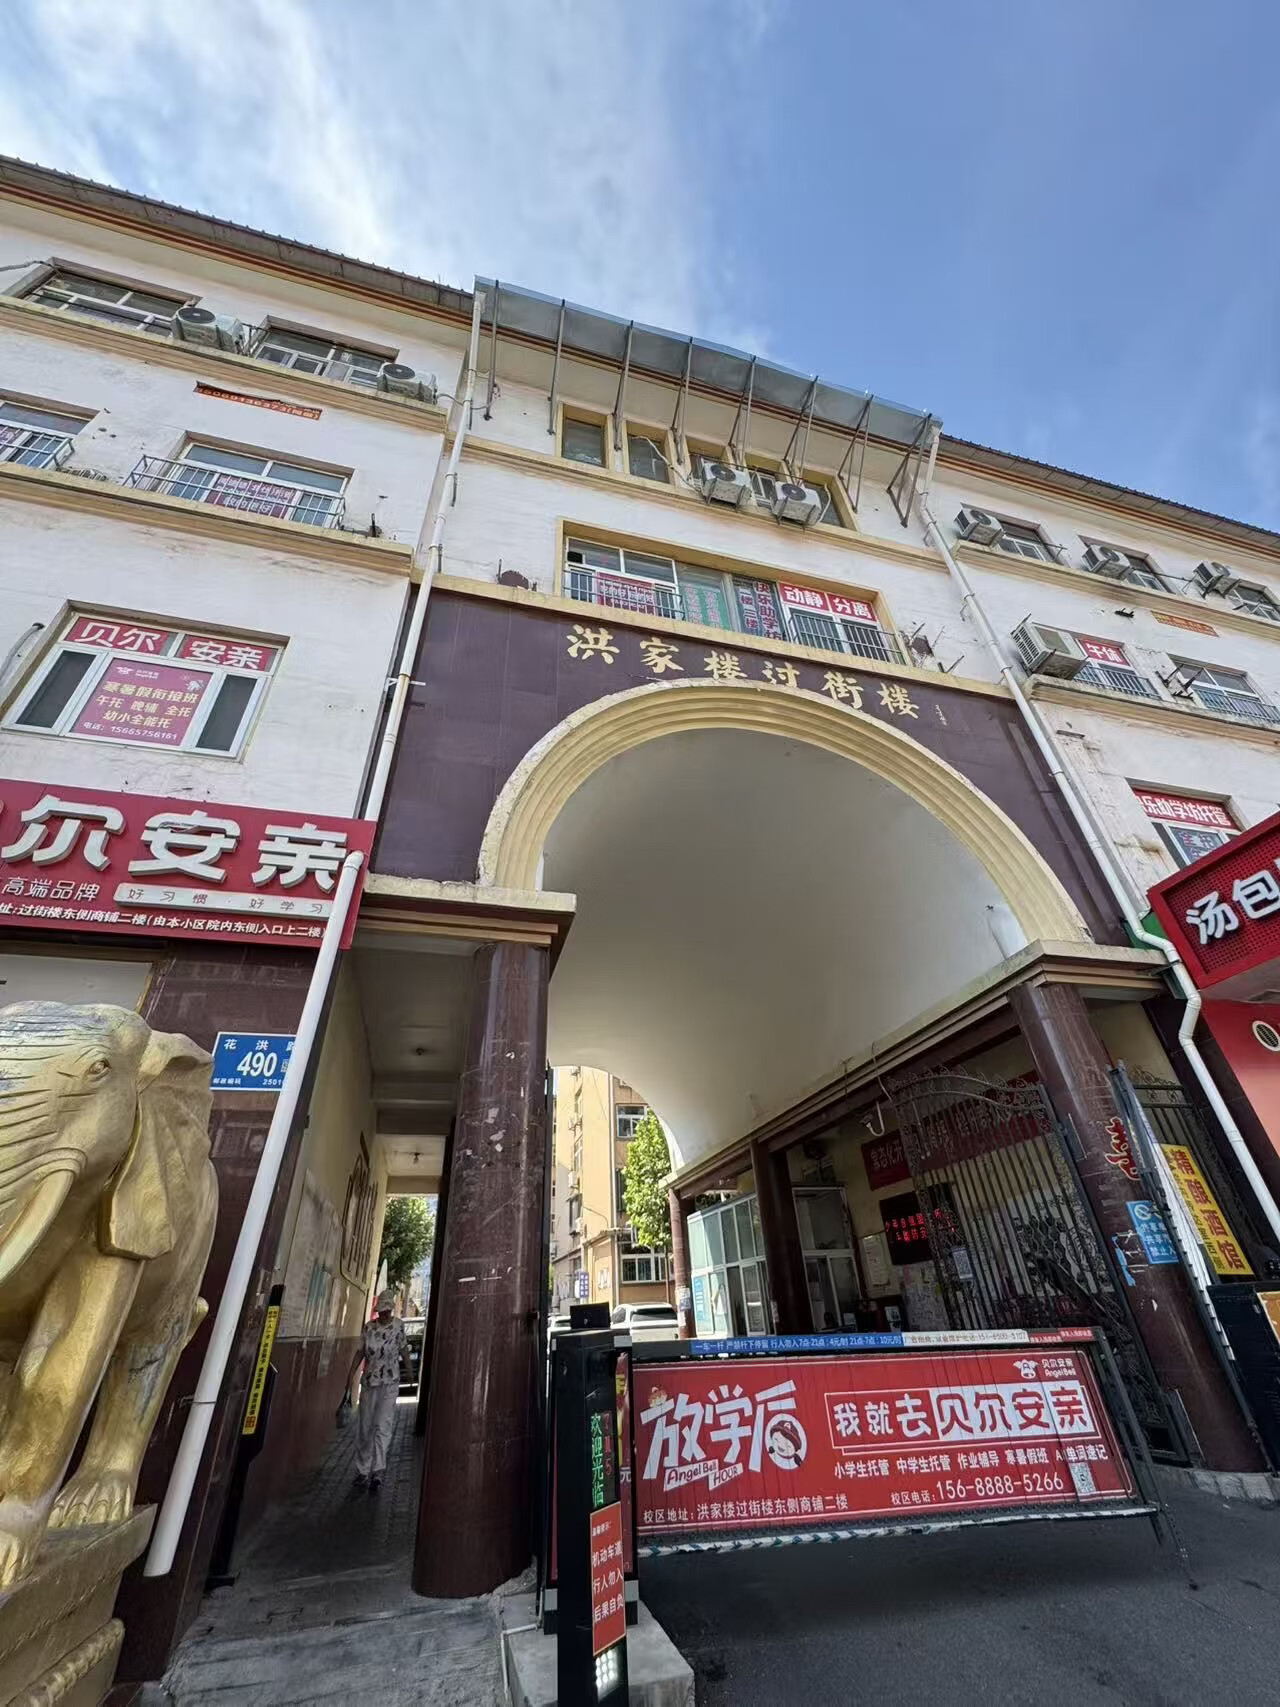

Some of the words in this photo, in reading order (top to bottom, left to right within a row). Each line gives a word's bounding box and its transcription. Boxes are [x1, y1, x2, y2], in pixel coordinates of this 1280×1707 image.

[784, 585, 824, 609] 动静
[833, 597, 873, 620] 分离
[74, 621, 162, 653] 贝尔
[184, 640, 264, 670] 安亲
[1086, 641, 1123, 663] 午休
[96, 694, 125, 710] 午托
[165, 704, 194, 719] 全托
[102, 681, 200, 705] 寒暑假衔接班
[103, 710, 174, 730] 幼小全能托
[0, 794, 348, 894] 尔安亲
[2, 877, 101, 901] 高端品牌
[1184, 857, 1280, 945] 汤包
[236, 1051, 278, 1077] 490
[640, 1379, 797, 1480] 放学后
[590, 1412, 604, 1507] 欢迎光临
[834, 1459, 891, 1480] 小学生托管
[896, 1454, 951, 1474] 中学生托管
[957, 1450, 1001, 1470] 作业辅导
[1004, 1447, 1050, 1466] 寒暑假班
[666, 1464, 701, 1486] Angel
[712, 1465, 740, 1487] HOUR
[936, 1472, 1065, 1500] 156-8888-5266
[592, 1540, 623, 1568] 机动车道
[593, 1567, 624, 1595] 行人勿入
[594, 1593, 625, 1624] 后果自负
